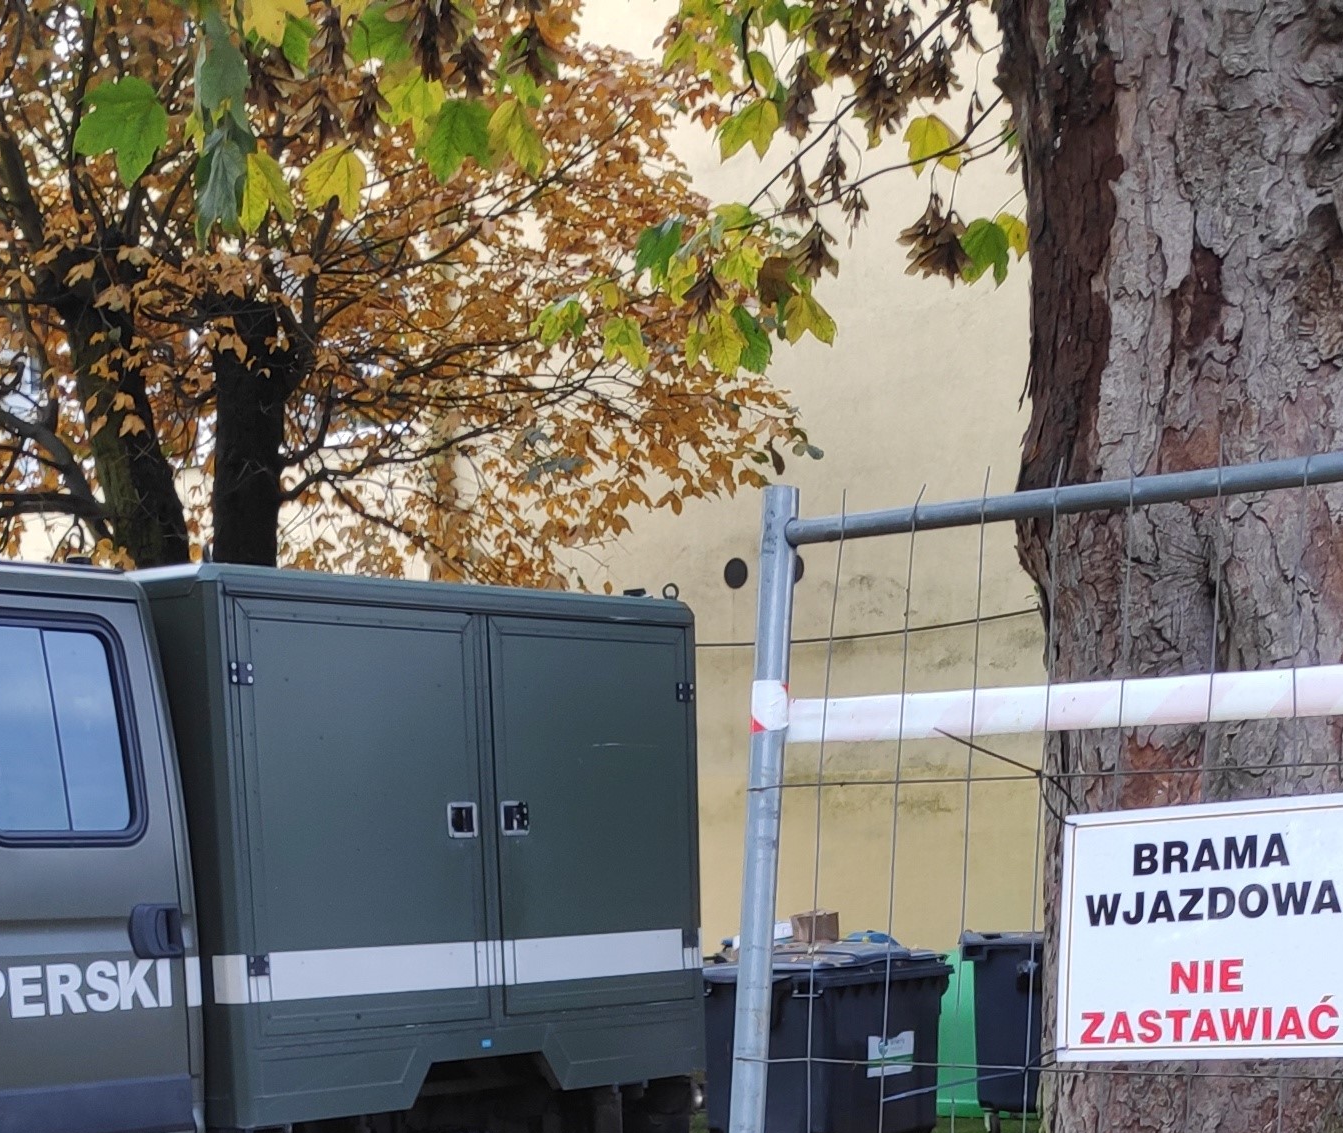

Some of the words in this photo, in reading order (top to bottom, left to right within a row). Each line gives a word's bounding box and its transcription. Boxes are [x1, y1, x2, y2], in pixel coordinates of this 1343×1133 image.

[1133, 833, 1290, 876] BRAMA
[1085, 880, 1342, 927] WJAZDOWA
[1170, 959, 1244, 994] NIE
[1080, 995, 1339, 1044] ZASTAWIAĆ
